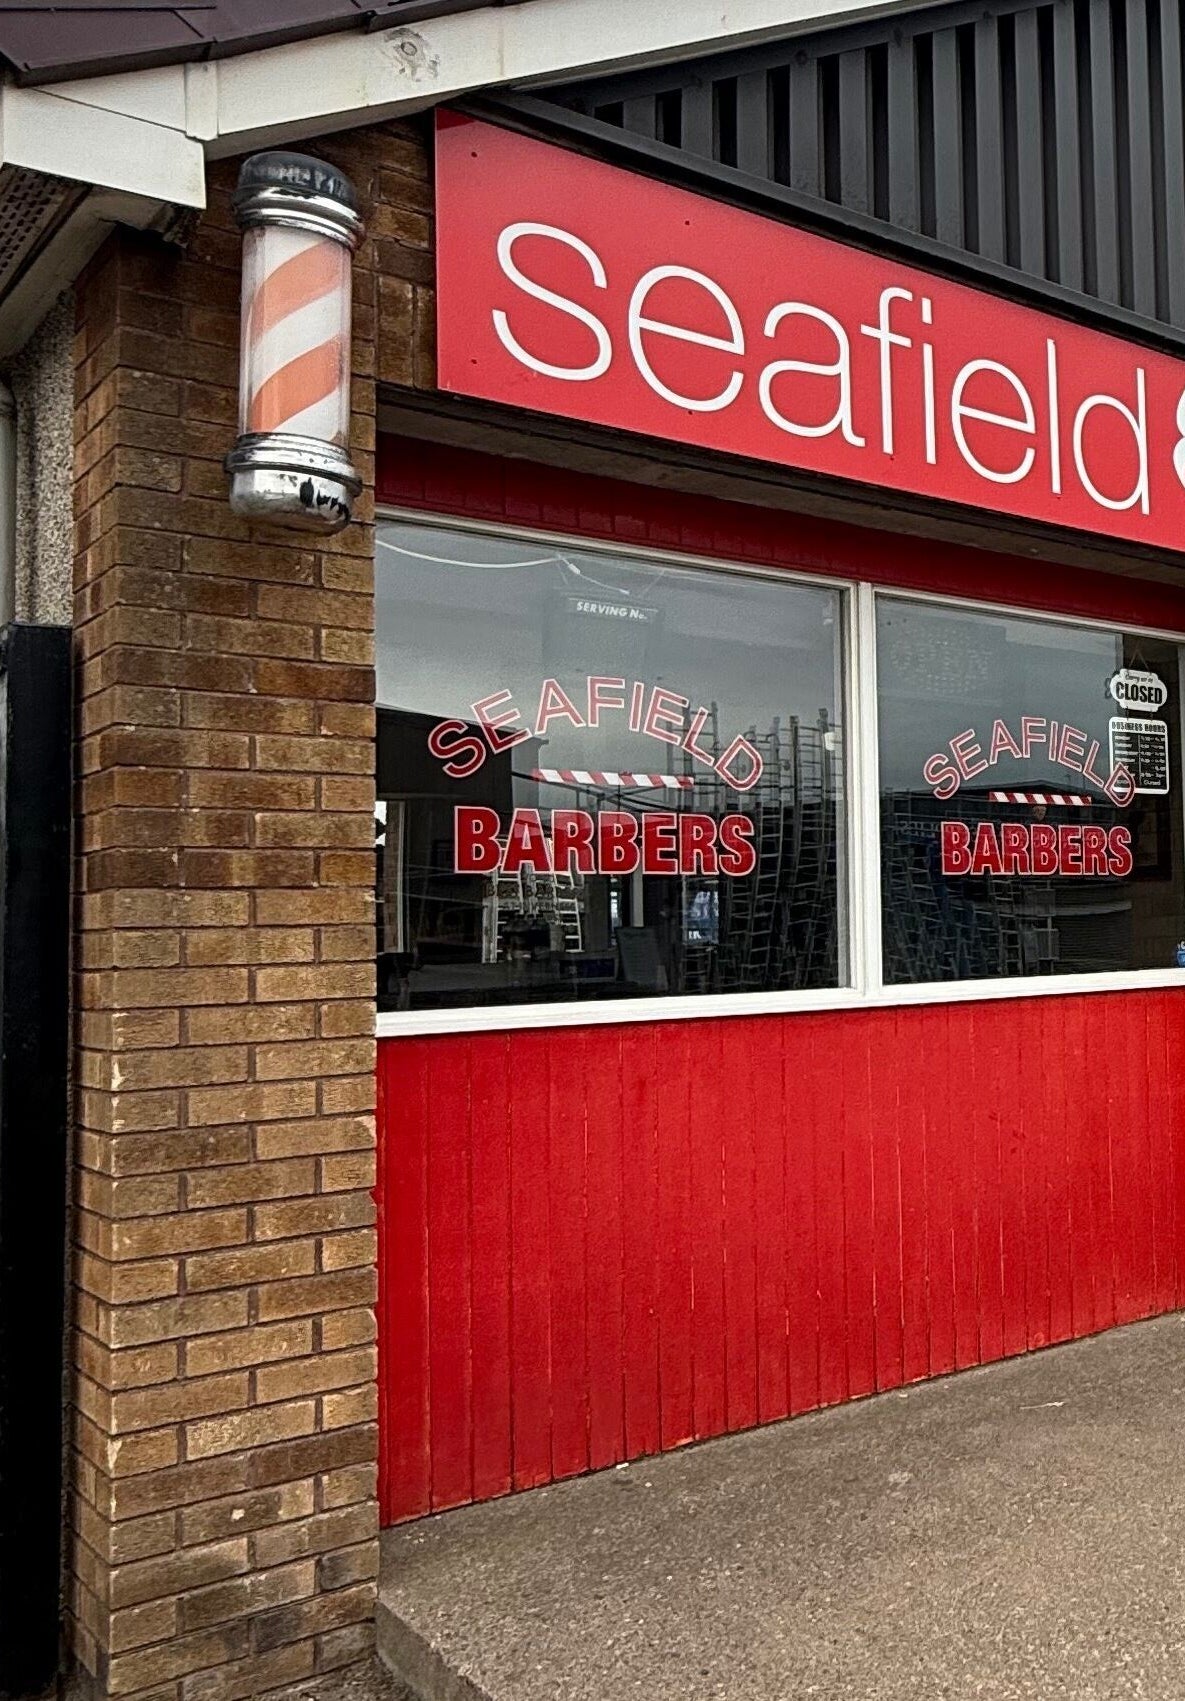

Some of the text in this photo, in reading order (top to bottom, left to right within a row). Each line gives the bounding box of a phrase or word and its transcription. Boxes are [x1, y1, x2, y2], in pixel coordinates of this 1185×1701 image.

[492, 222, 1150, 514] seafield
[576, 601, 628, 617] SERVING
[1116, 682, 1162, 704] CLOSED
[427, 676, 763, 791] SEAFIELD
[923, 716, 1136, 808] SEAFIELD
[454, 806, 757, 877] BARBERS
[940, 821, 1133, 877] BARBERS
